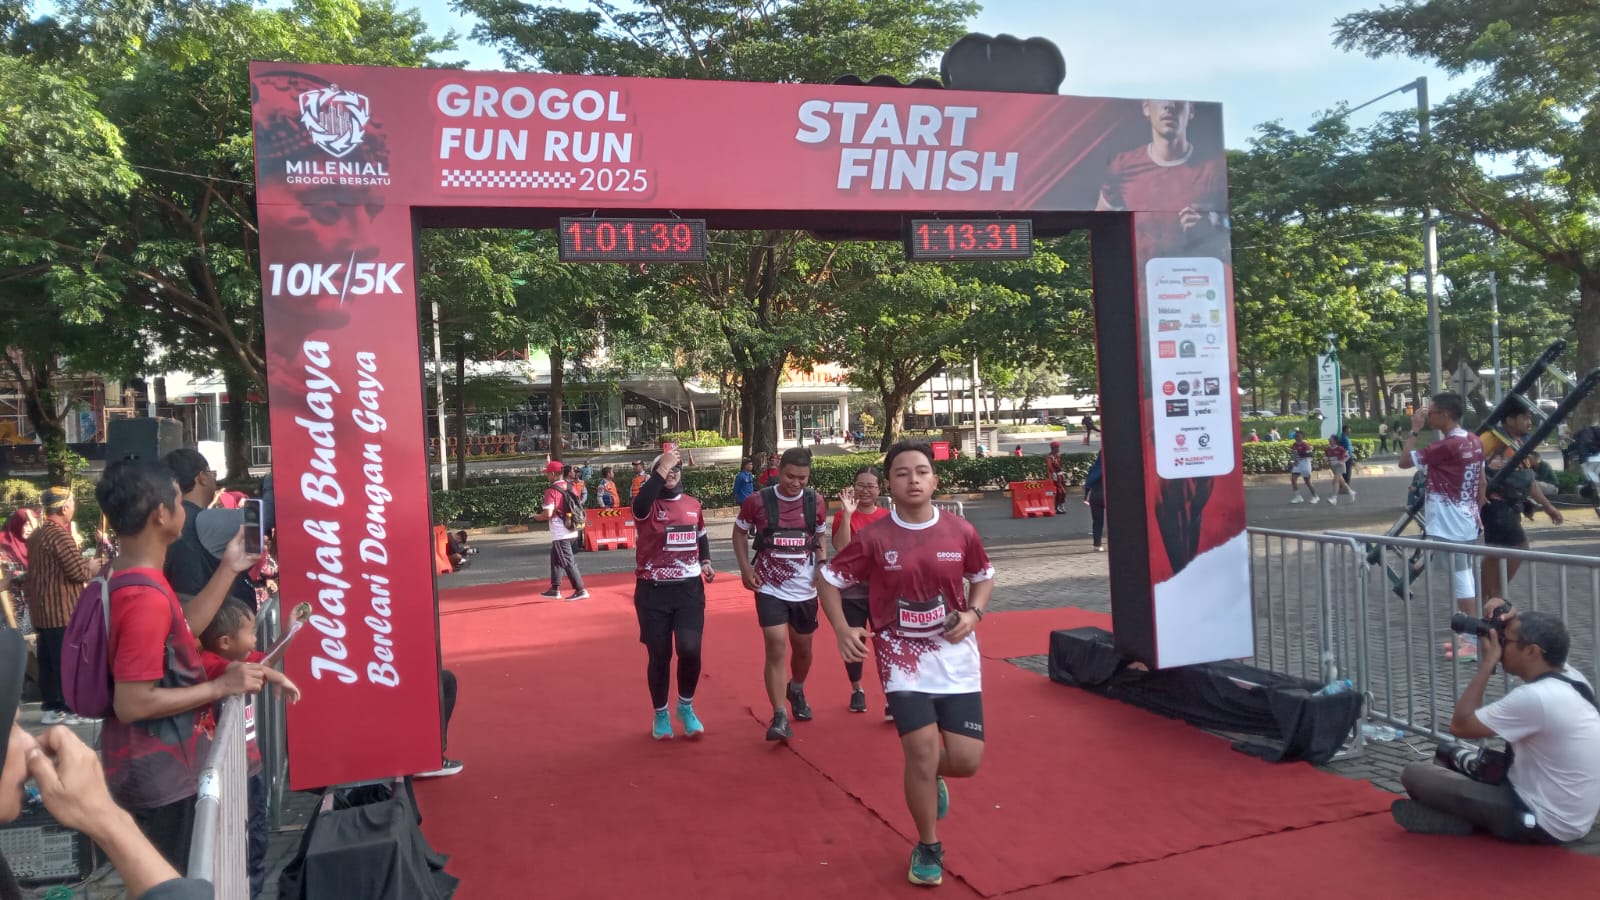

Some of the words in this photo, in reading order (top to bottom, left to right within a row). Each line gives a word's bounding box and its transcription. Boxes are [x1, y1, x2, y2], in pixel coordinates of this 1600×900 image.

[436, 84, 627, 122] GROGOL
[795, 100, 978, 147] START
[440, 128, 529, 160] FUN
[544, 131, 633, 163] RUN
[285, 160, 389, 176] MILENIAL
[286, 176, 335, 184] GROGOL
[339, 177, 391, 185] BERSATU
[579, 168, 648, 192] 2025
[836, 148, 1019, 192] FINISH
[568, 222, 692, 252] 1:01:39
[917, 223, 1018, 250] 1:13:31
[351, 351, 388, 434] Gaya
[295, 340, 344, 508] Budaya
[359, 443, 393, 567] Dengan
[303, 519, 358, 684] Jelajah
[901, 606, 945, 623] M50932
[361, 573, 400, 687] Berlari
